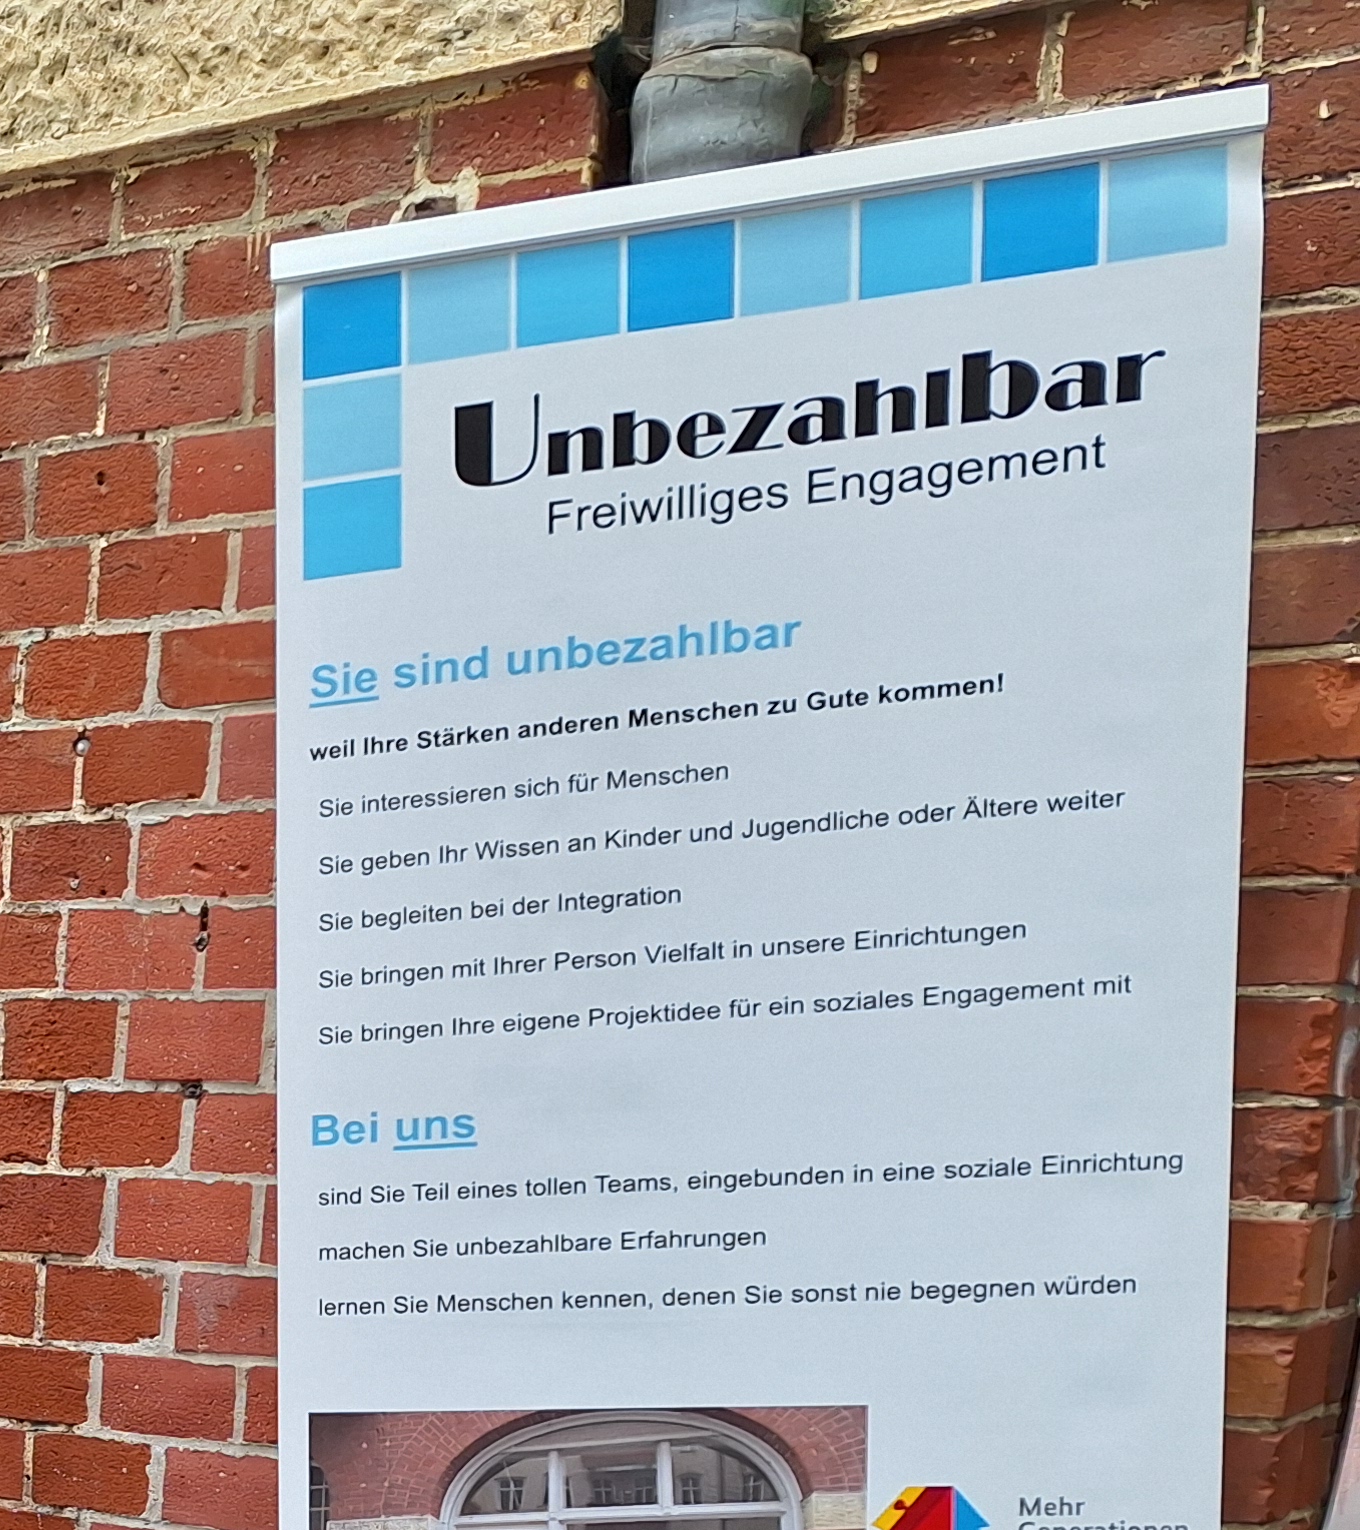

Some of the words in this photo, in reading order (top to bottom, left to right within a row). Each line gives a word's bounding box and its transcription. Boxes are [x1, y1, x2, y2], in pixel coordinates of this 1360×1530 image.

[454, 349, 1166, 487] Unbezahlbar
[548, 482, 789, 535] Freiwilliges
[807, 434, 1106, 506] Engagement
[309, 662, 380, 709] Sie
[393, 645, 489, 689] sind
[507, 619, 802, 676] unbezahlbar
[309, 738, 355, 761] weil
[363, 736, 409, 756] Ihre
[416, 725, 509, 750] Stärken
[517, 715, 619, 739] anderen
[628, 701, 759, 729] Menschen
[767, 698, 797, 716] zu
[806, 688, 869, 711] Gute
[878, 672, 1004, 705] kommen!
[311, 1111, 378, 1147] Bei
[392, 1114, 479, 1152] uns
[1018, 1496, 1086, 1517] Mehr
